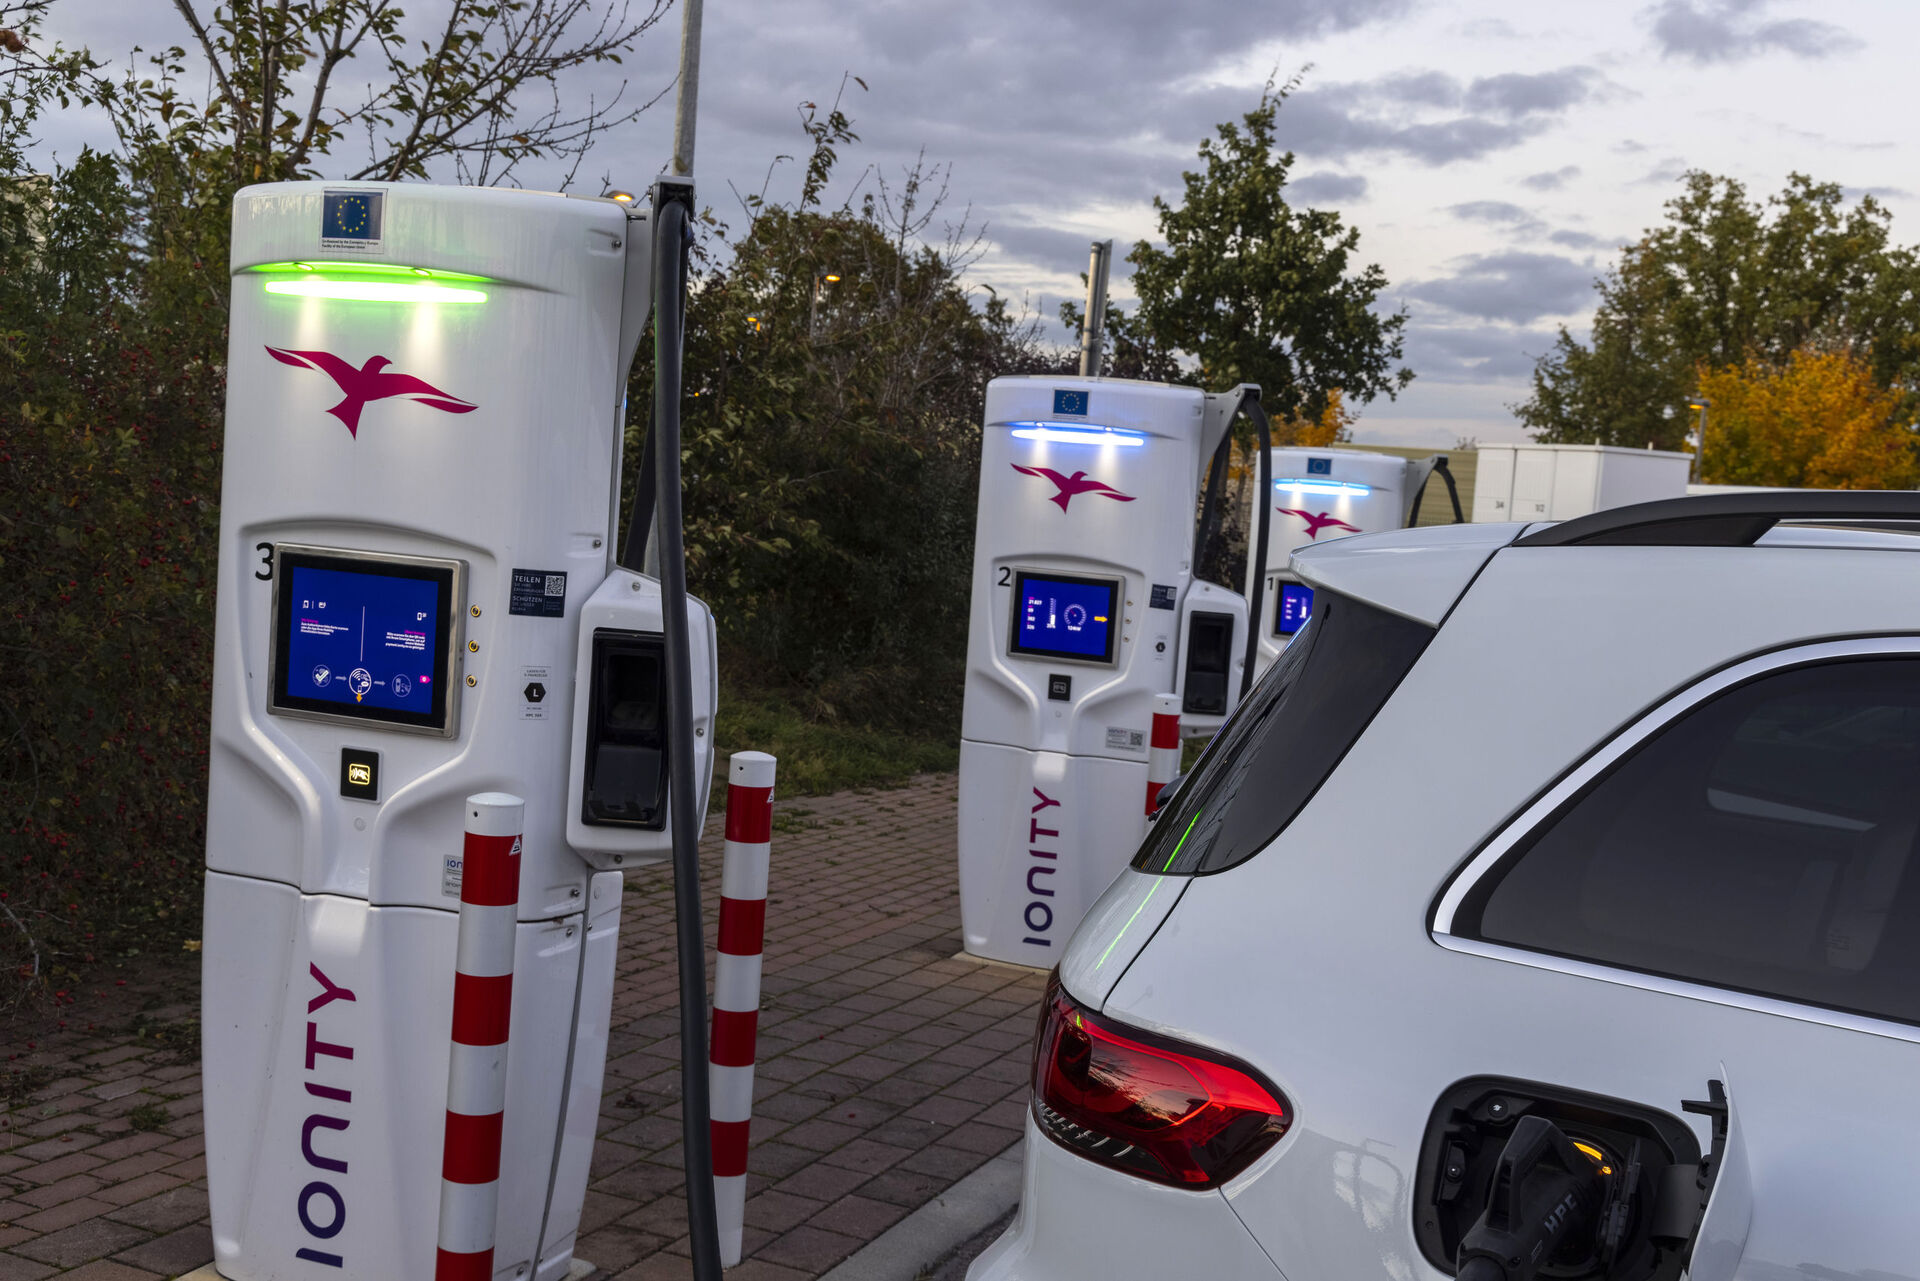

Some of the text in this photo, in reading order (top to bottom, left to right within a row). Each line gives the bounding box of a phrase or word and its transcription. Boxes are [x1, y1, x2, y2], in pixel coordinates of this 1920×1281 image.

[255, 542, 274, 581] 3
[998, 566, 1011, 587] 2
[514, 575, 540, 584] TEILEN
[1267, 577, 1274, 590] 1
[533, 688, 540, 698] L
[1022, 786, 1061, 947] IONITY
[296, 961, 356, 1268] IONITY
[1544, 1193, 1576, 1234] HPC
